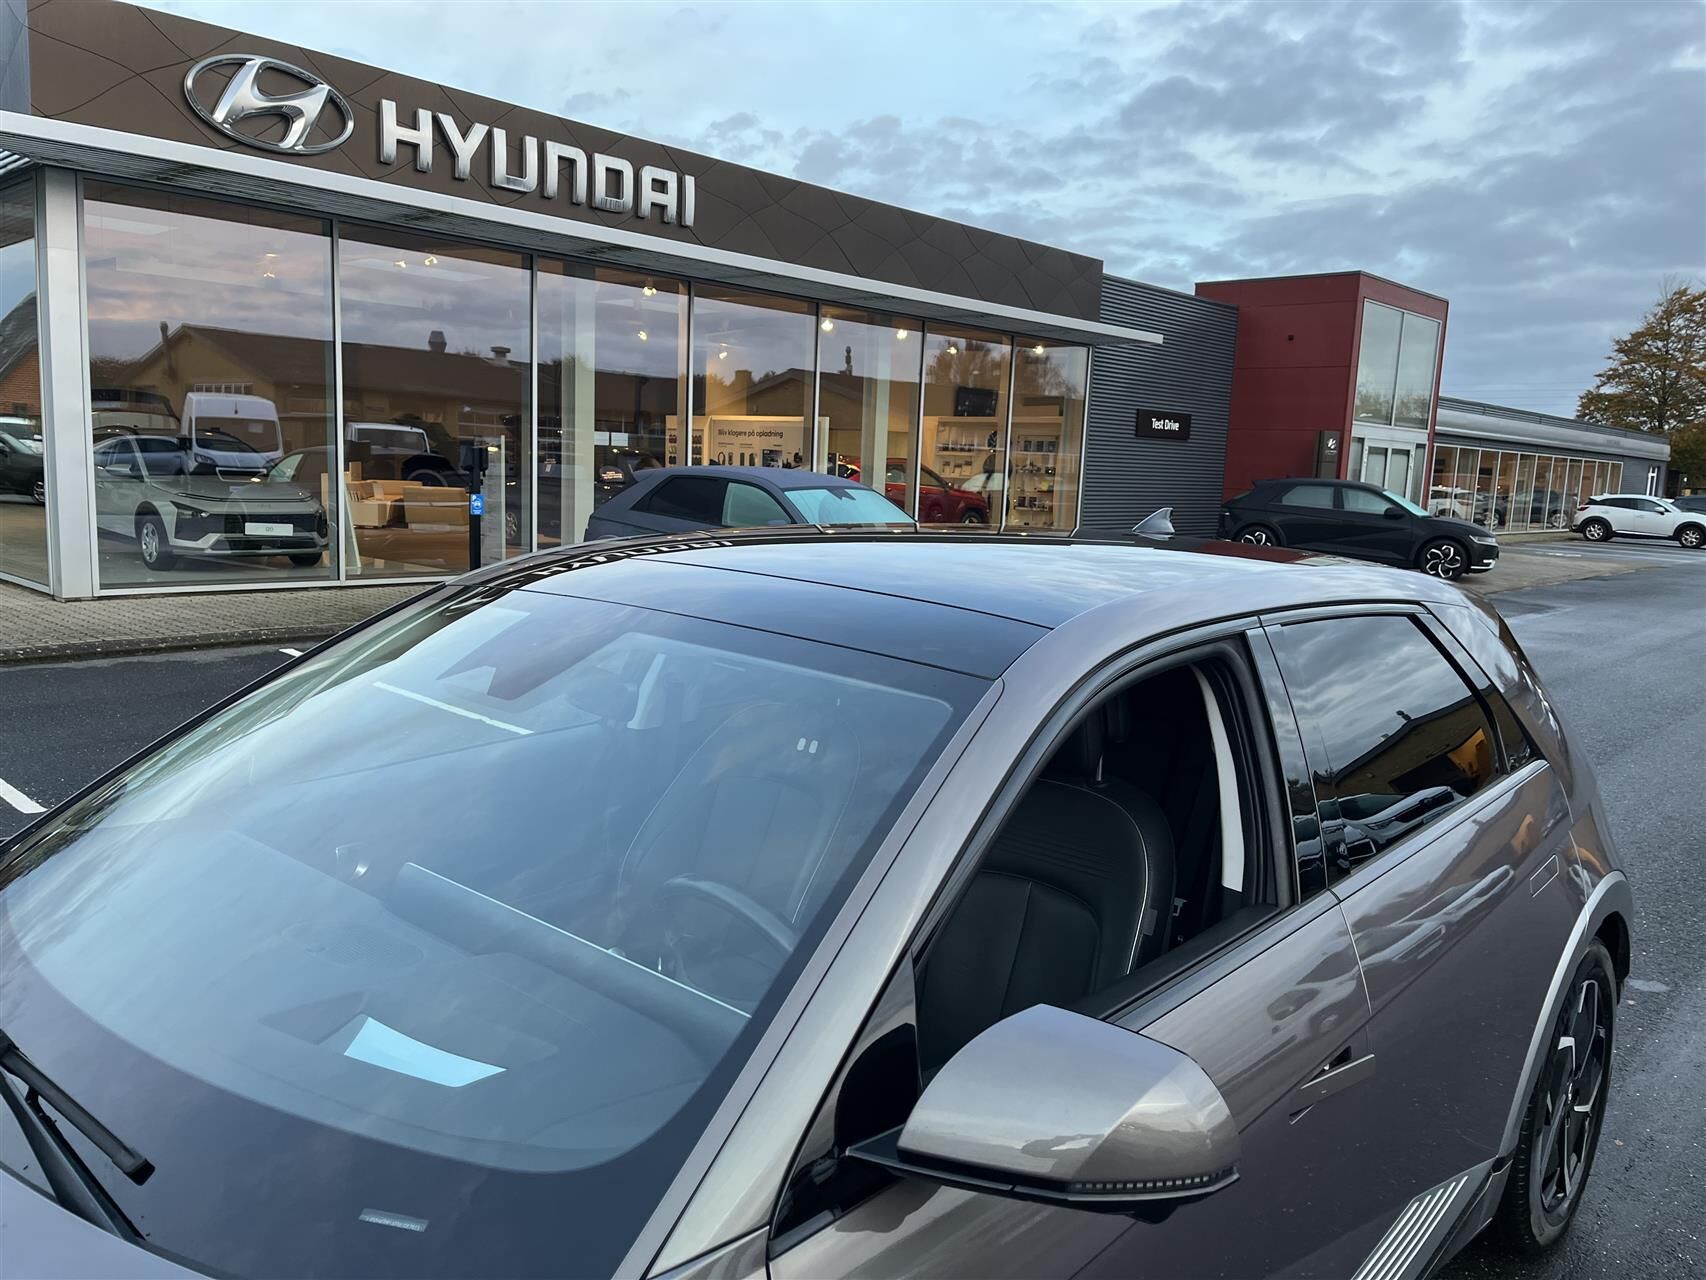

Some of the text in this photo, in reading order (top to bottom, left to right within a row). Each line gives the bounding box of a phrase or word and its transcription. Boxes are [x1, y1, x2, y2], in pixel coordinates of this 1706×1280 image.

[378, 98, 696, 227] HYUNDAI
[1151, 418, 1180, 431] Test Drive
[728, 429, 747, 437] klogere
[748, 429, 755, 437] på
[756, 430, 784, 438] opladning
